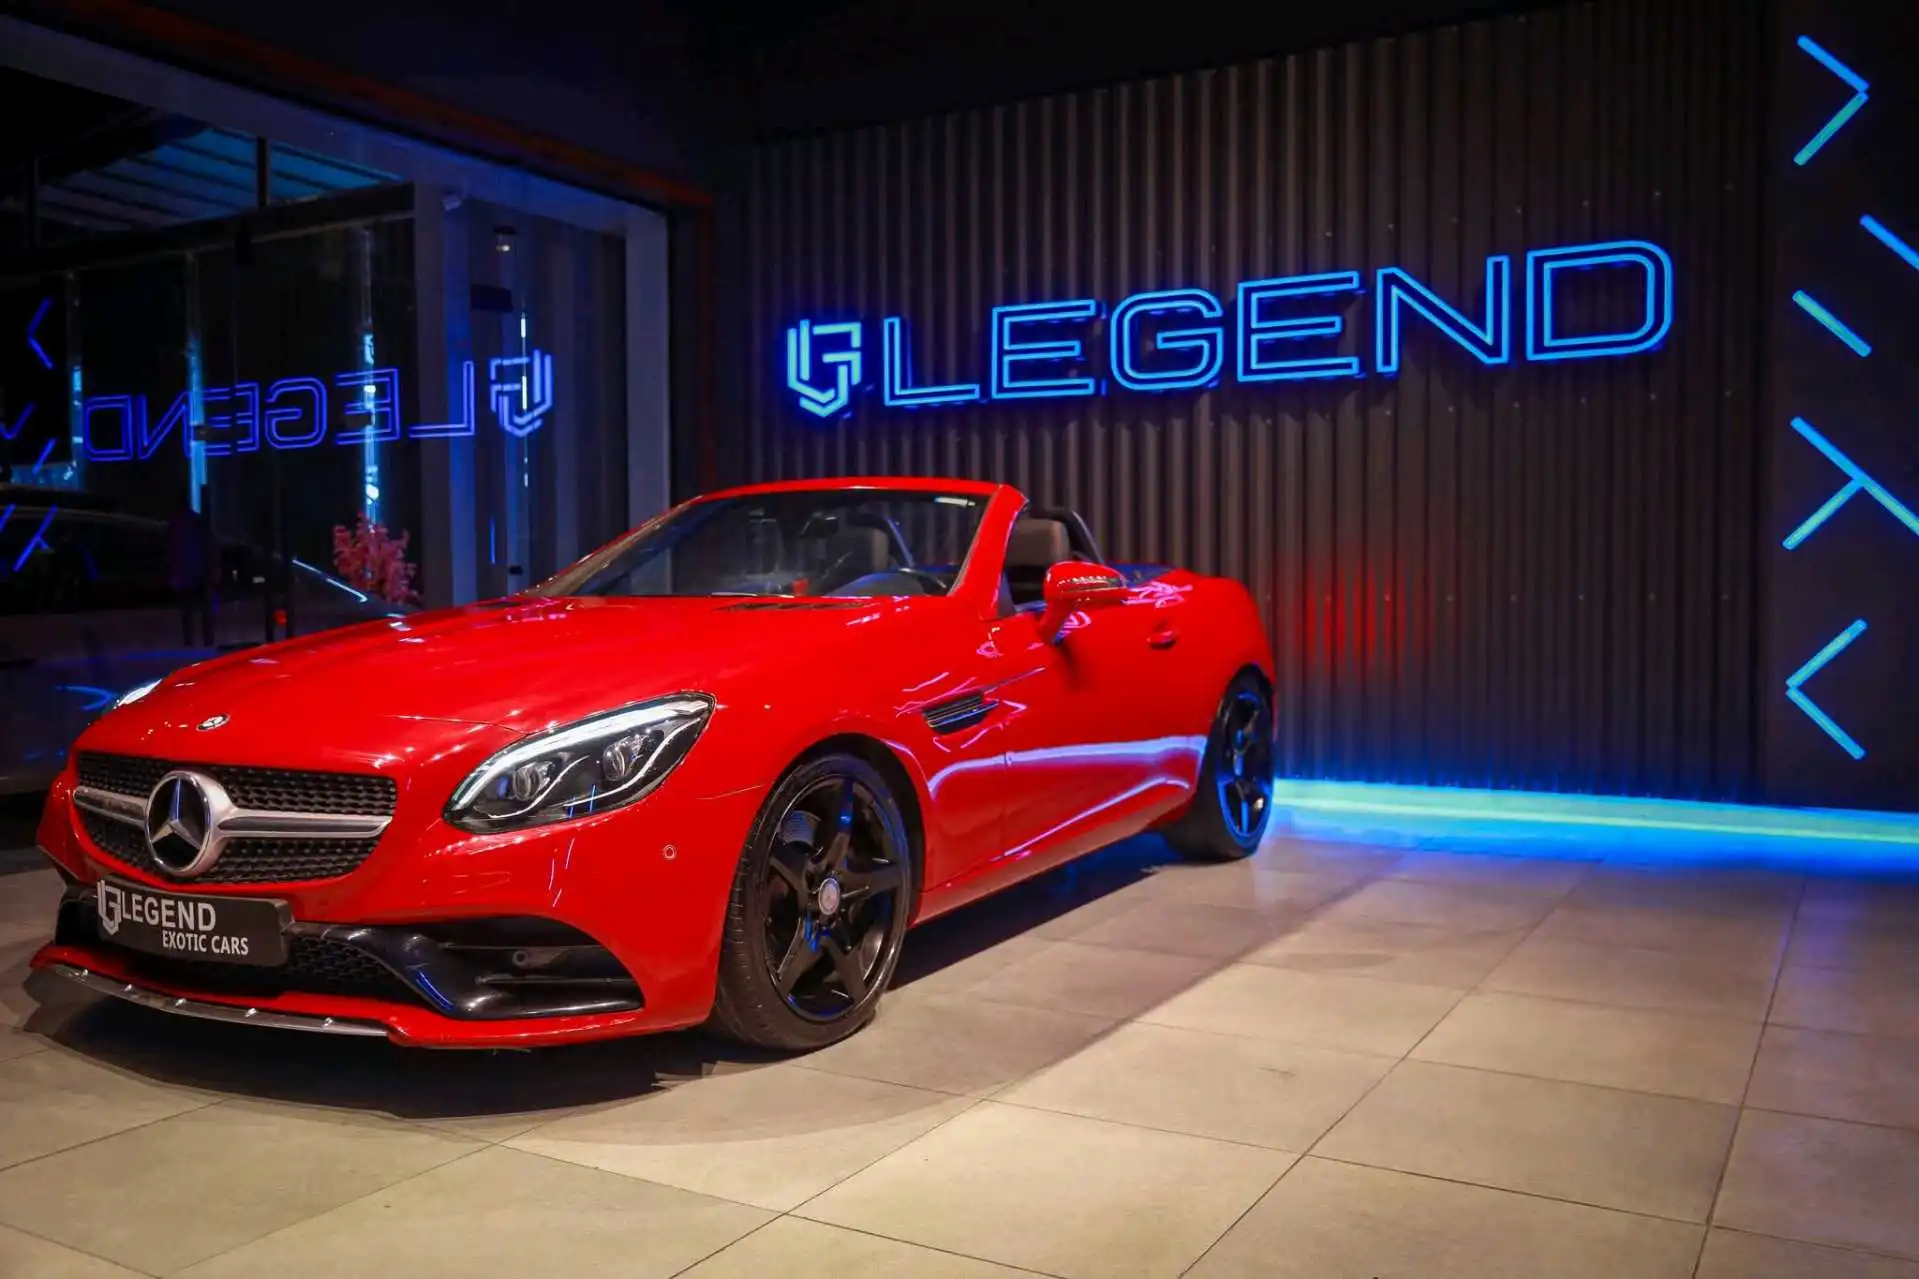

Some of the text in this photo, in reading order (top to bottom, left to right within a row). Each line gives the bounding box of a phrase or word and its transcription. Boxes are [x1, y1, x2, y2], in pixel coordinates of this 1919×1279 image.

[883, 240, 1674, 407] LEGEND
[121, 891, 217, 932] LEGEND
[162, 930, 249, 955] EXOTIC CARS
